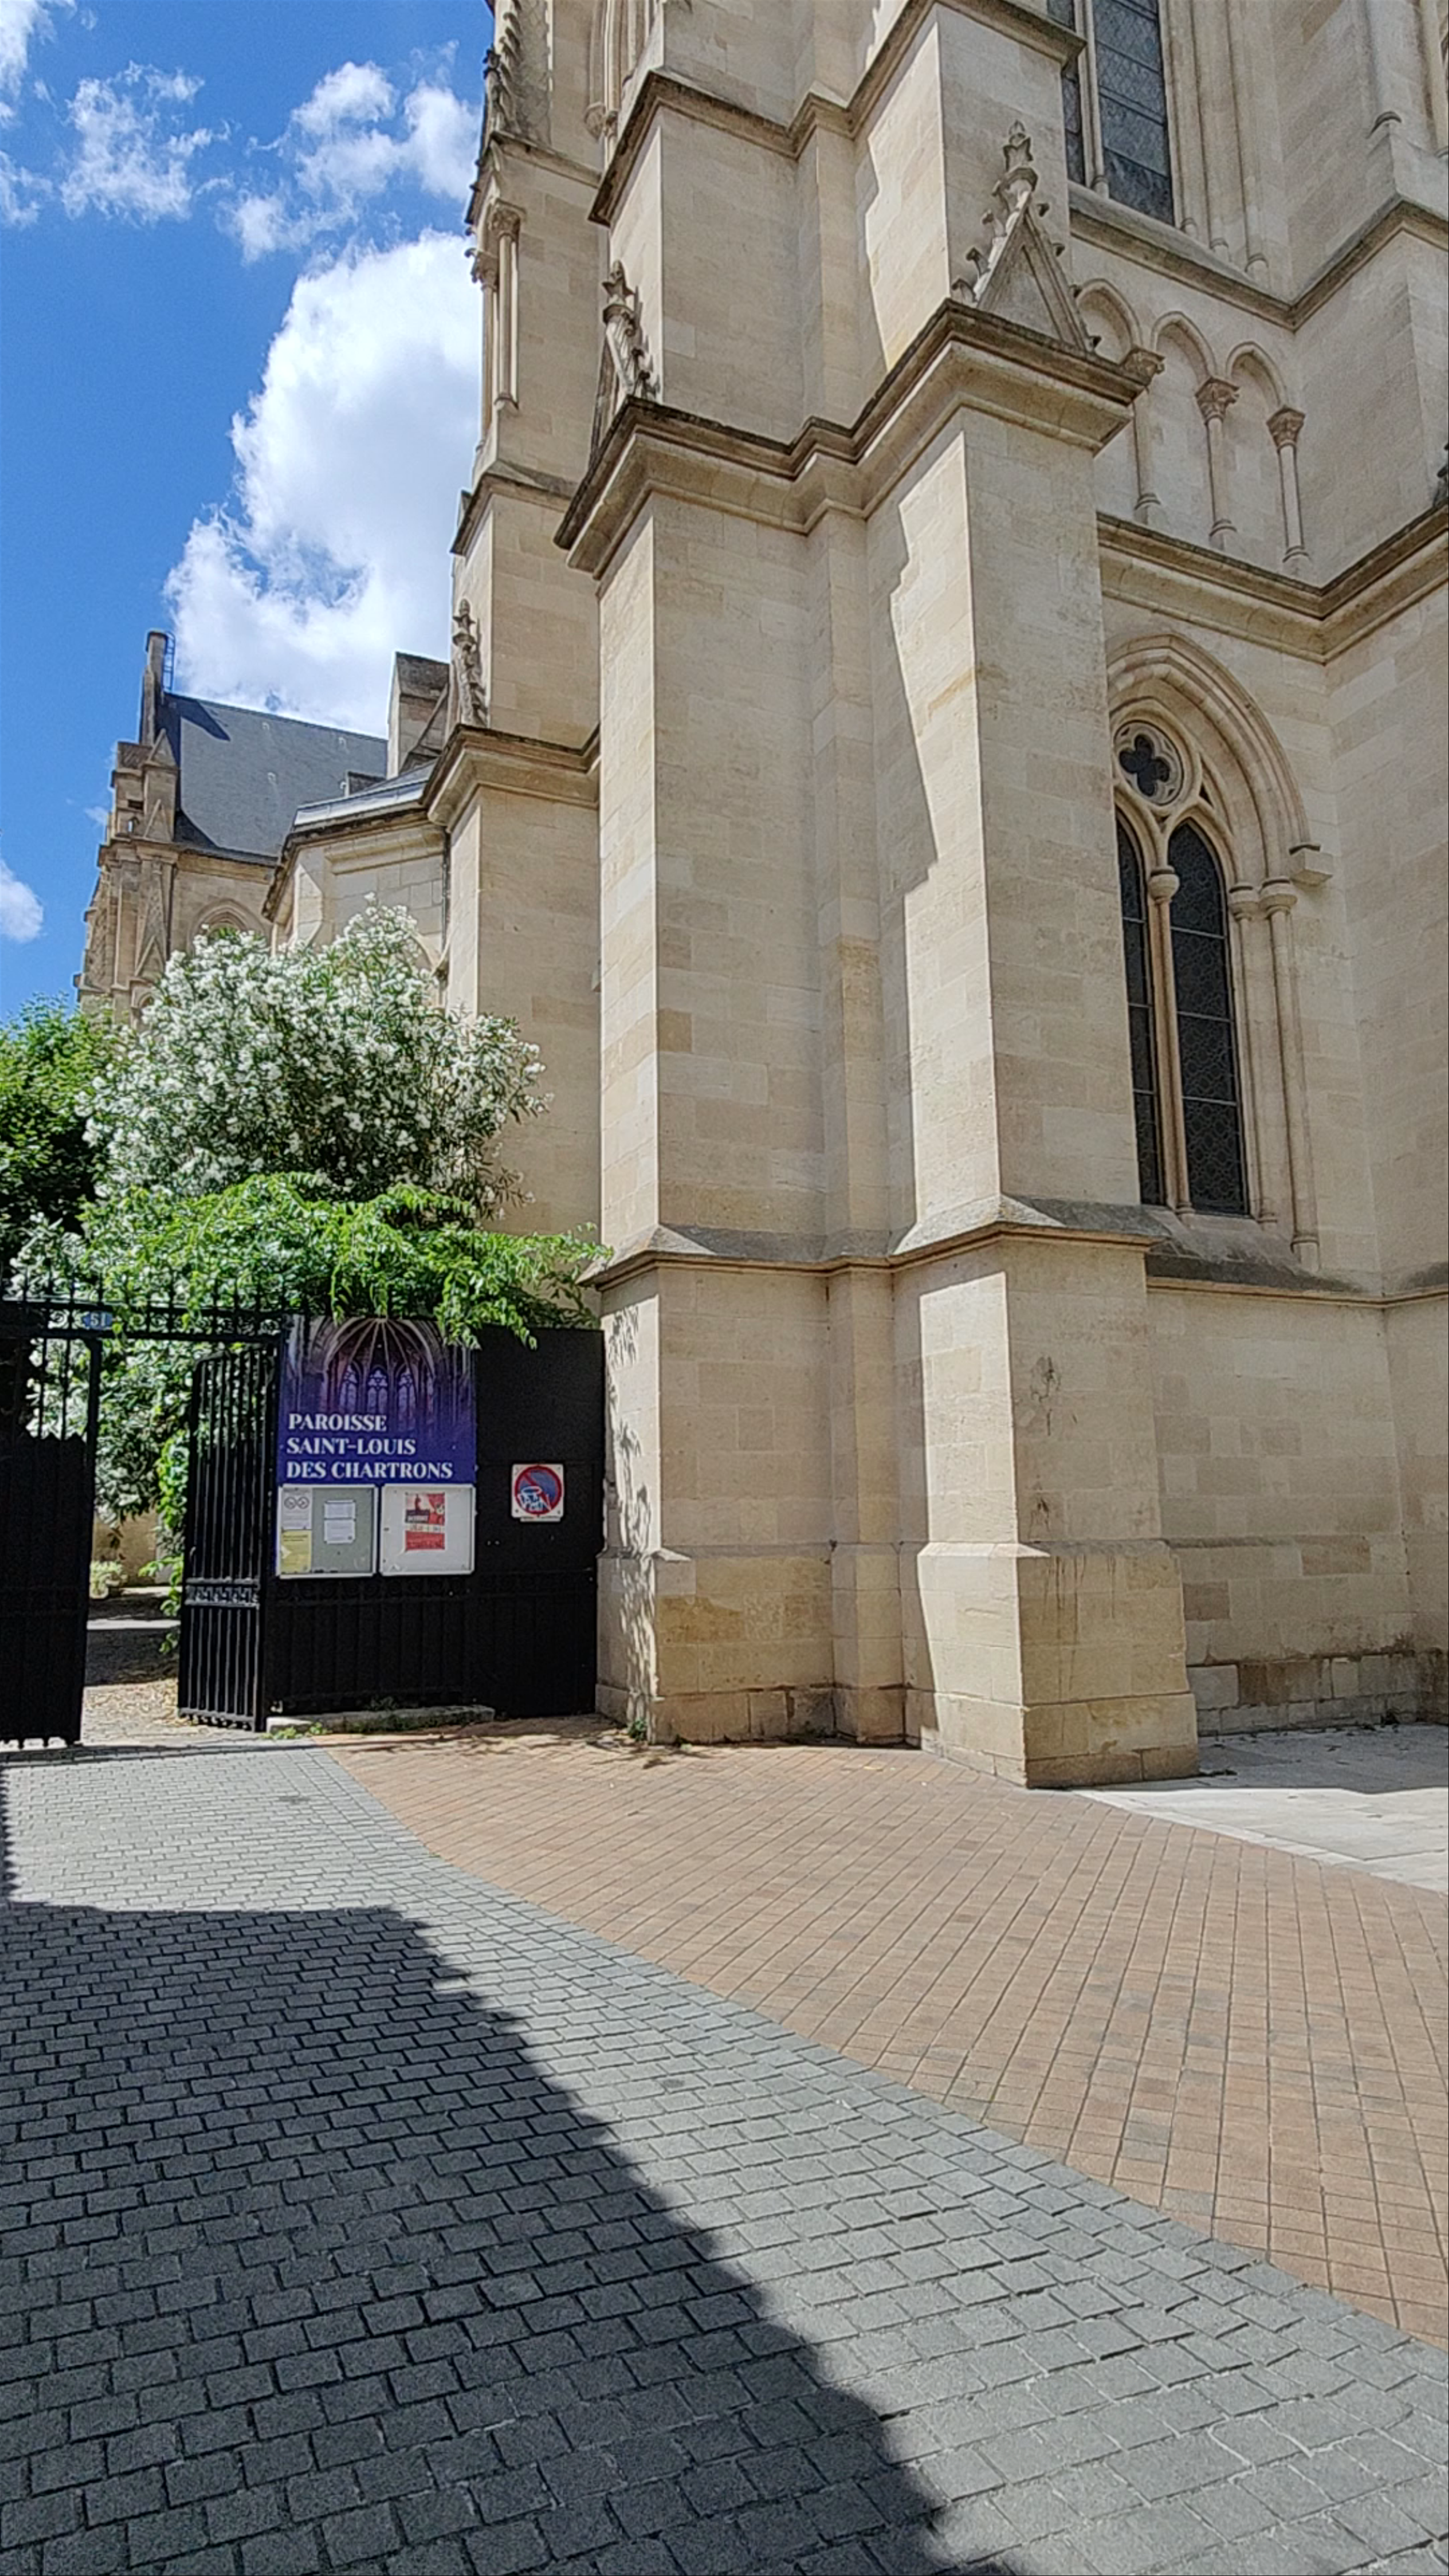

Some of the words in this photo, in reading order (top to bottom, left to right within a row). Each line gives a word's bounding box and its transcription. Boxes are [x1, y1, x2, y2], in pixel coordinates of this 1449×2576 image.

[91, 1312, 106, 1326] 51
[288, 1413, 387, 1431] PAROISSE
[286, 1437, 416, 1455] SAINT-LOUIS
[286, 1461, 326, 1478] DES
[331, 1461, 453, 1478] CHARTRONS
